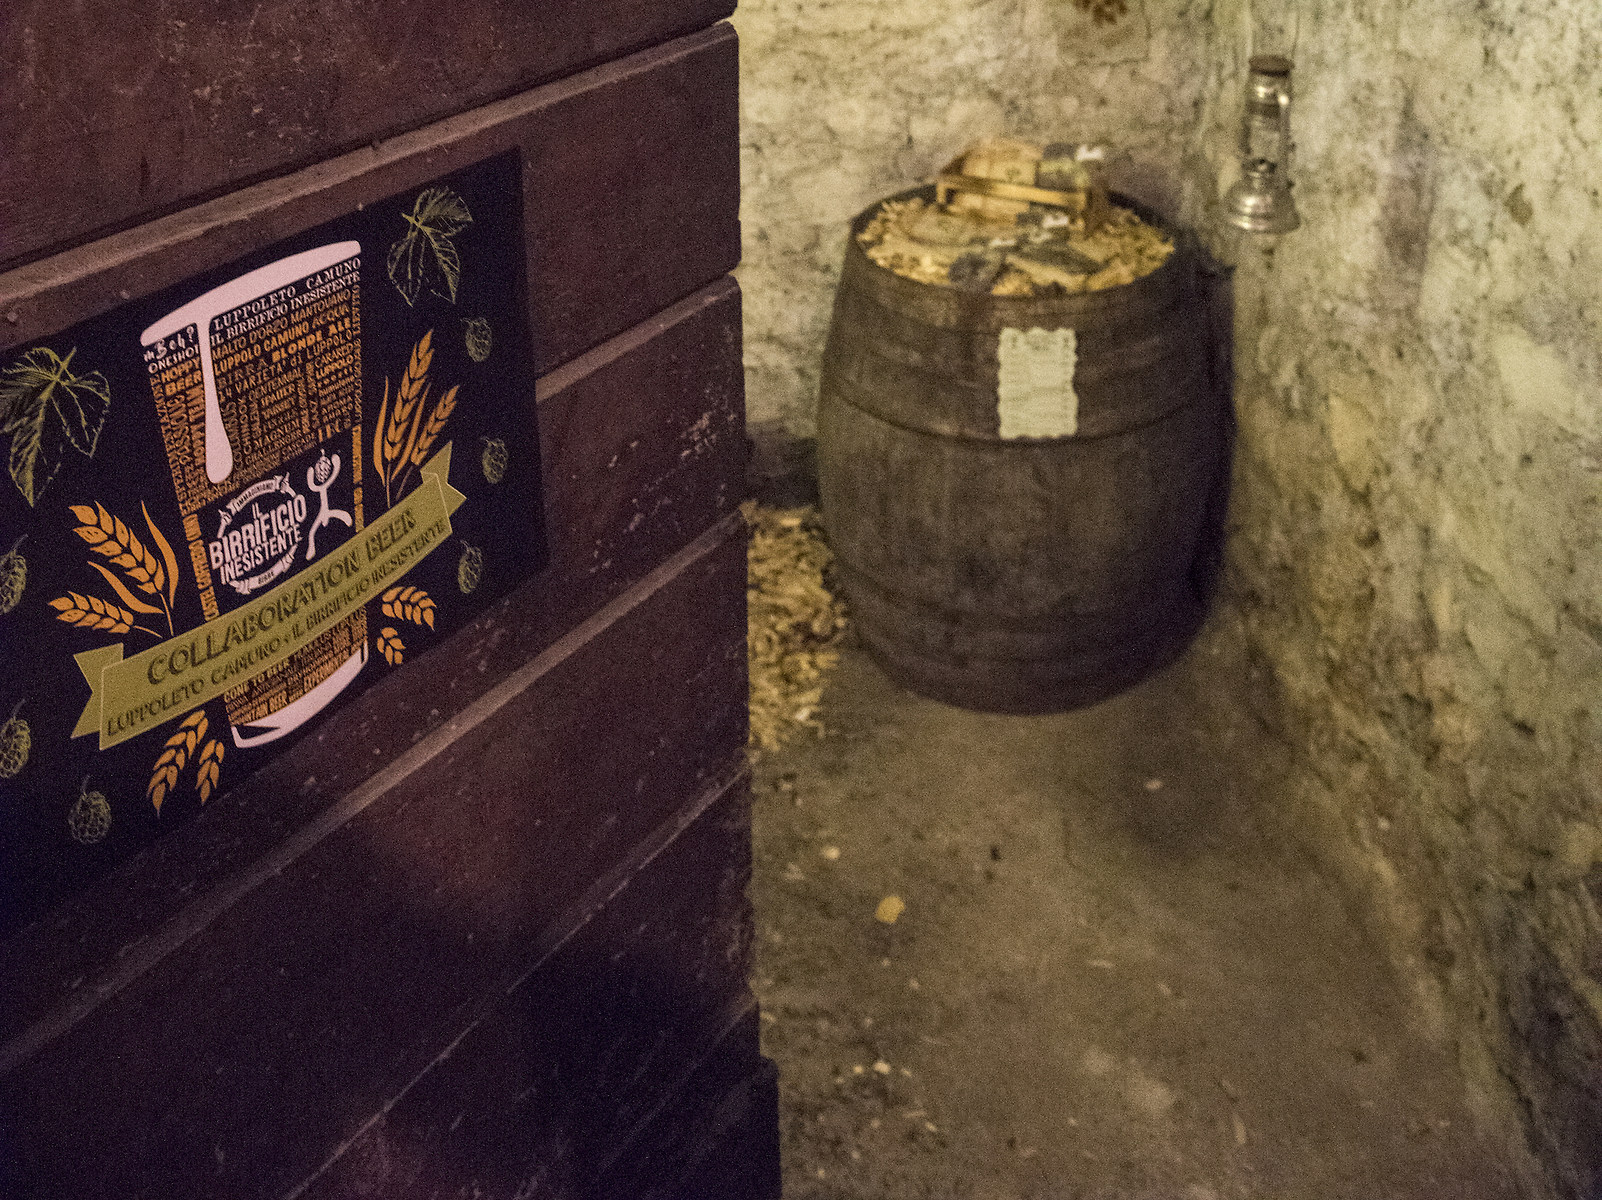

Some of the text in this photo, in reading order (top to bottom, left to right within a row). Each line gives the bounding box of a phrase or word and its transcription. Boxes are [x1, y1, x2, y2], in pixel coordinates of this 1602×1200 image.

[210, 271, 361, 347] IL BIRRIFICIO INESISTENTE
[212, 336, 246, 361] MALTO
[290, 289, 351, 324] MANTOVANO
[213, 257, 361, 331] LUPPOLETO CAMUNO
[161, 356, 201, 383] HOPPY
[213, 344, 261, 376] LUPPOLO
[263, 321, 309, 351] CAMUNO
[272, 330, 323, 363] BLONDE
[328, 317, 352, 338] ALE
[306, 330, 352, 360] LUPPOLO
[165, 370, 202, 397] BEER
[209, 493, 307, 570] BIRRIFICIO
[251, 501, 262, 520] IL
[219, 523, 304, 586] INESISTENTE
[147, 549, 360, 685] COLLABORATION
[365, 509, 416, 562] BEER
[107, 679, 205, 737] LUPPOLETO
[211, 637, 284, 685] CAMUNO
